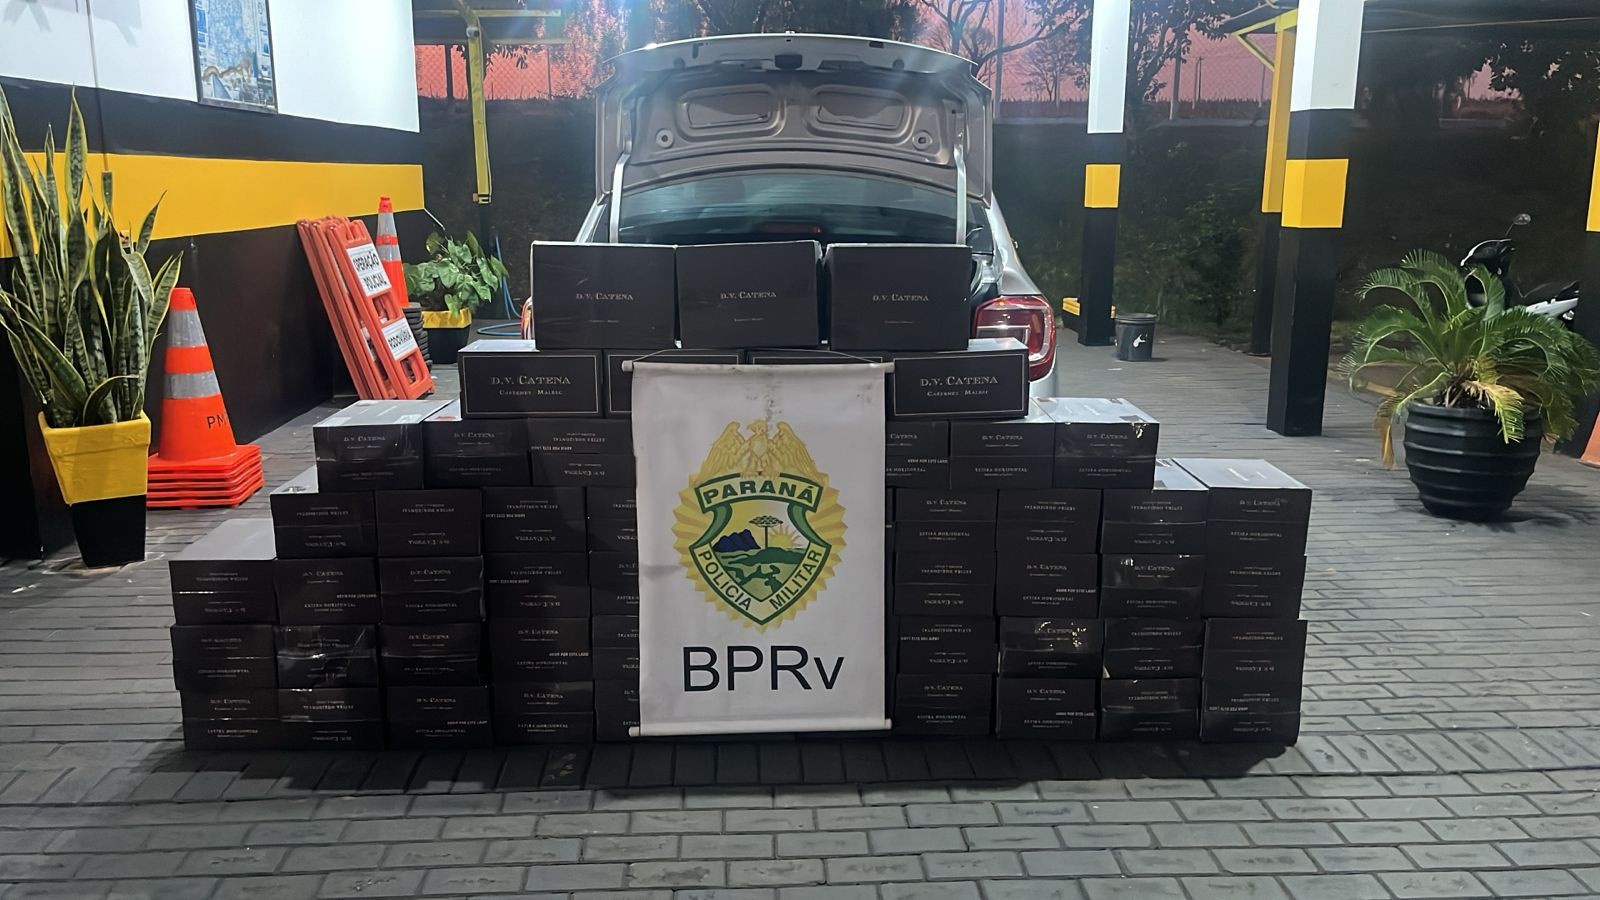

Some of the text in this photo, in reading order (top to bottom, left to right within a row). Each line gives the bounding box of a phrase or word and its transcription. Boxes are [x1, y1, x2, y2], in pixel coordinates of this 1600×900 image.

[739, 291, 777, 299] CATENA
[892, 294, 929, 302] CATENA
[492, 376, 571, 385] D.V. CATENA
[920, 376, 998, 387] D.V. CATENA
[703, 480, 814, 504] PARANÁ
[770, 550, 822, 610] MILITAR
[683, 646, 844, 692] BPRv
